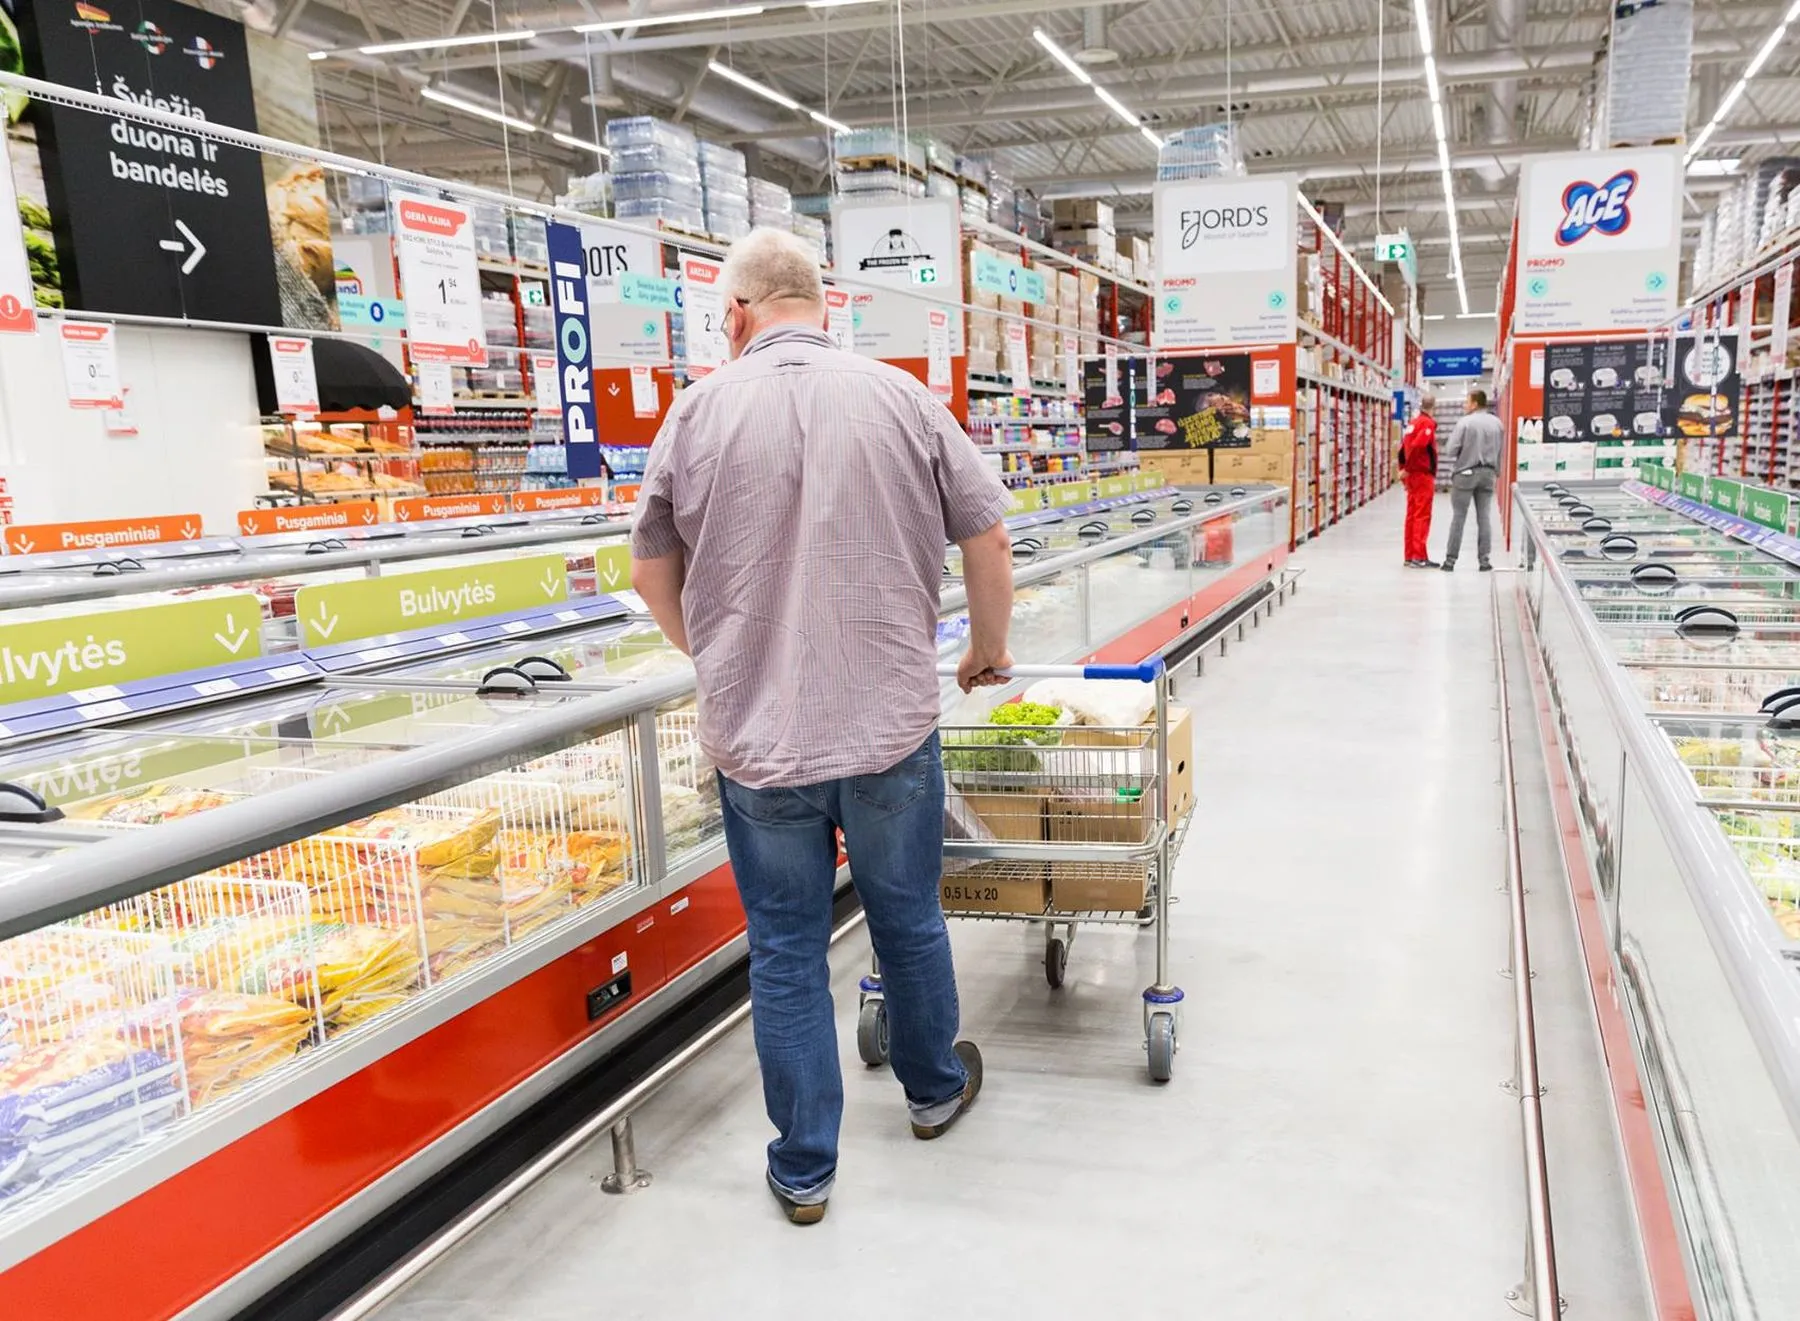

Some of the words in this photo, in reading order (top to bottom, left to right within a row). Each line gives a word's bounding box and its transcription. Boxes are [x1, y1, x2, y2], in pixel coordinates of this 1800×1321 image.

[110, 118, 196, 158] duona
[109, 150, 229, 197] bandelės
[1560, 181, 1633, 230] ACE
[1181, 205, 1268, 250] FJORD'S
[582, 245, 629, 278] OTS
[1526, 258, 1565, 268] PROMO
[438, 279, 446, 304] 1
[1163, 278, 1196, 287] PROMO
[555, 261, 595, 444] PROFI
[276, 511, 348, 531] Pusgaminiai
[423, 501, 481, 519] Pusgaminiai
[61, 525, 160, 549] Pusgaminiai
[400, 579, 496, 617] Bulvytės
[0, 635, 127, 686] lvytės
[944, 886, 961, 901] 0,5
[965, 886, 972, 900] L
[984, 887, 998, 901] 20
